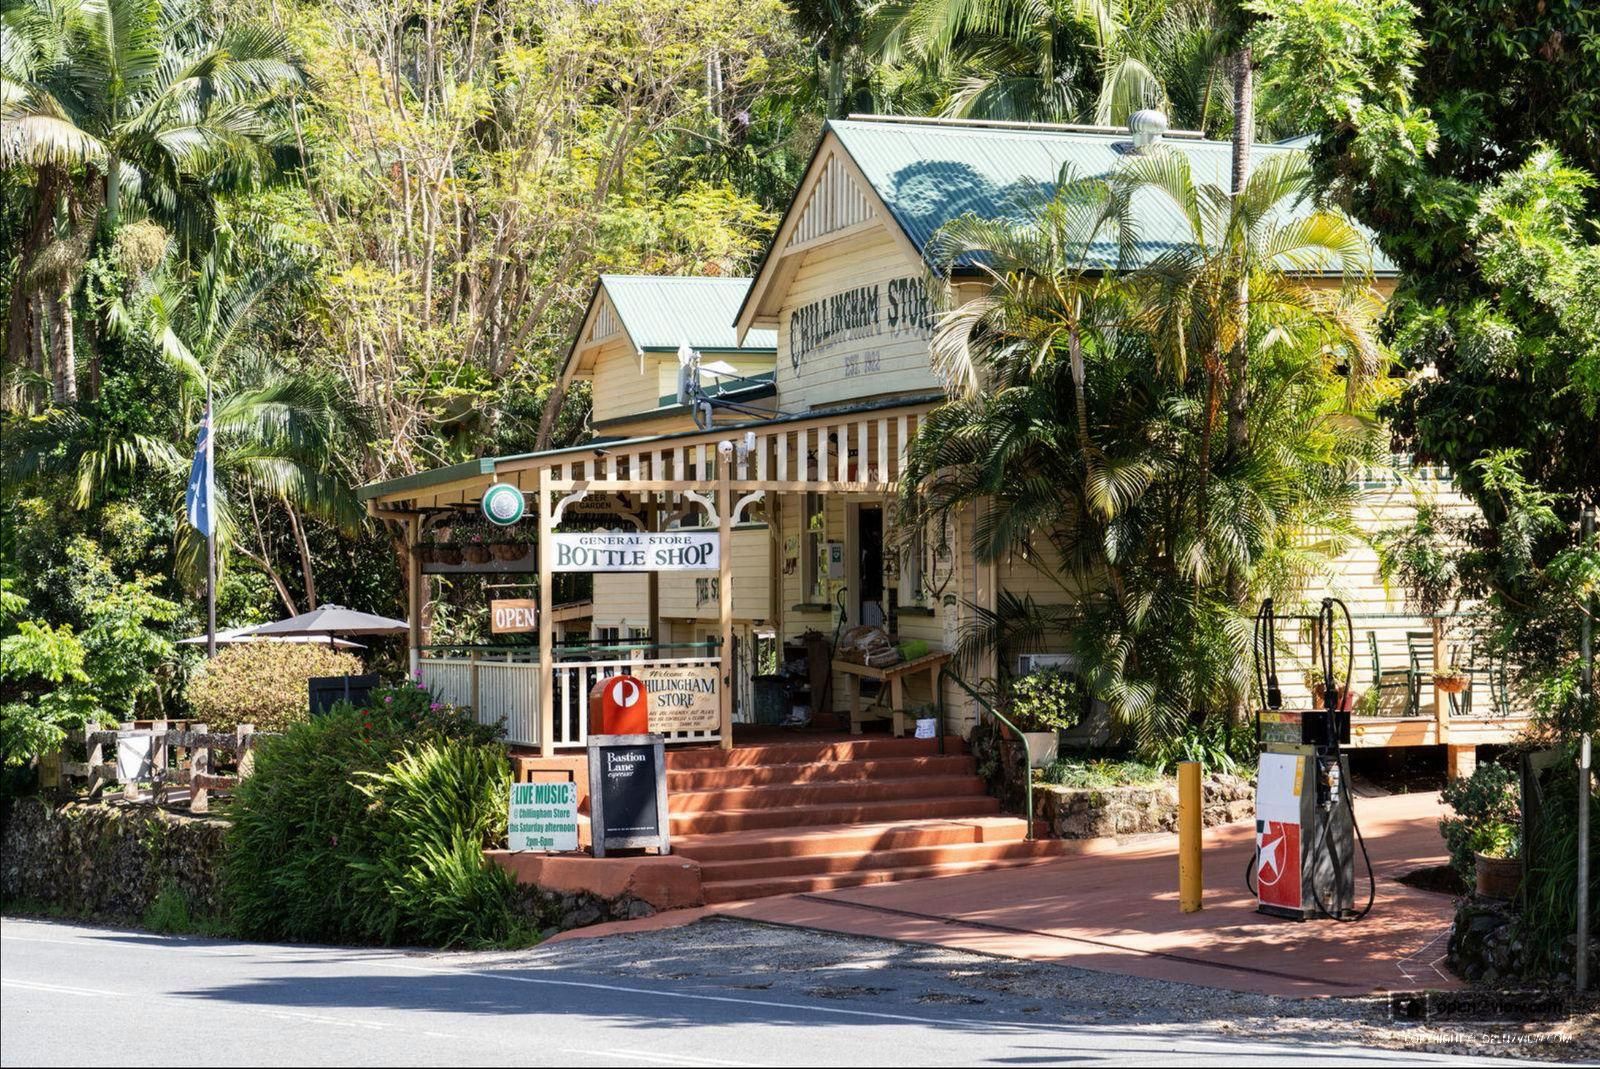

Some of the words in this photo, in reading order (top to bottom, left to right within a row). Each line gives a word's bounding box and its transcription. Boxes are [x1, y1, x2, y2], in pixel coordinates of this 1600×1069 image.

[790, 284, 879, 370] CHILLINGHAM
[579, 501, 612, 510] GARDEN
[579, 536, 643, 545] GENERAL
[649, 536, 692, 545] STORE
[556, 543, 646, 566] BOTTLE
[655, 542, 714, 566] SHOP
[496, 607, 535, 628] OPEN
[641, 678, 715, 694] HILLINGHAM
[658, 693, 695, 709] STORE
[607, 751, 646, 762] Bastion
[607, 762, 634, 772] Lane
[515, 785, 534, 805] LIVE
[535, 784, 569, 805] MUSIC
[519, 808, 552, 819] Chillingham
[553, 808, 570, 818] Store
[519, 822, 544, 833] Saturday
[544, 822, 576, 833] afternoon
